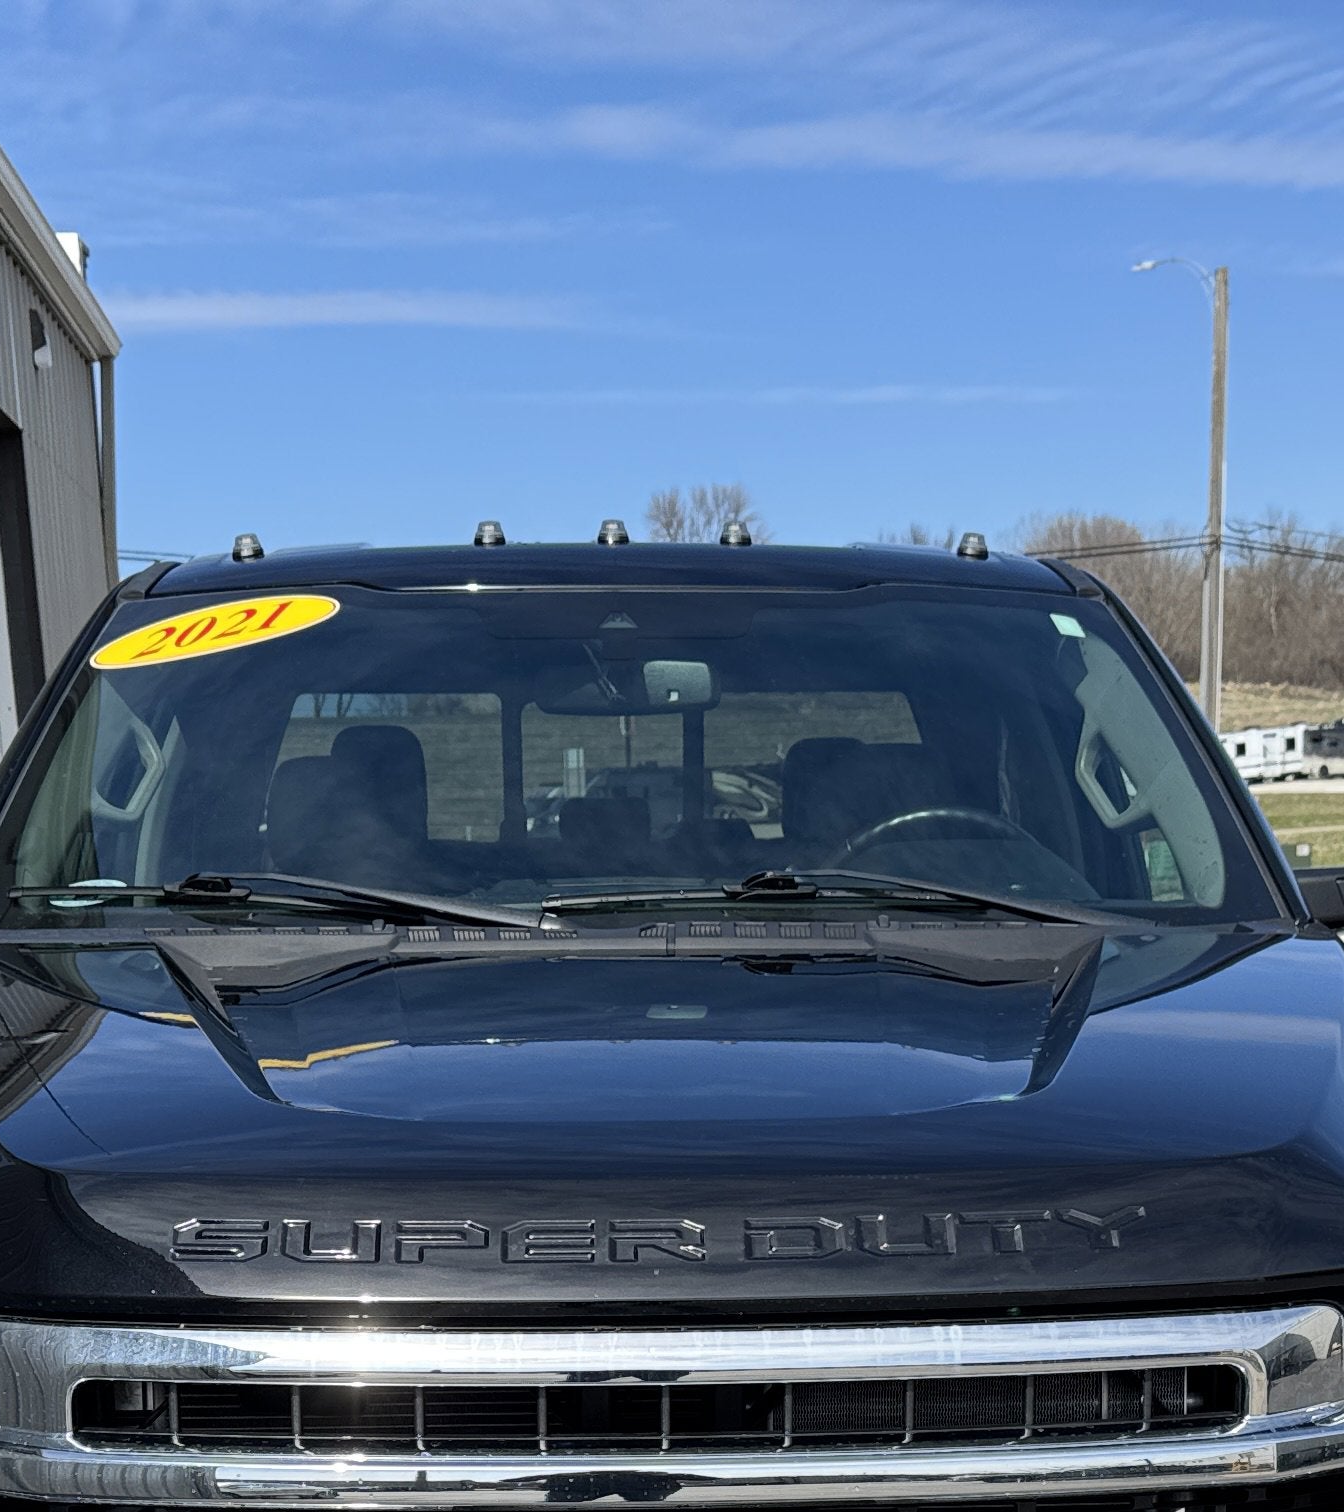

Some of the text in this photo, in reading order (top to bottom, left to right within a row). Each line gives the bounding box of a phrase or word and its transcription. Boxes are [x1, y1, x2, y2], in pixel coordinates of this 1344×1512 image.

[129, 601, 294, 660] 2021
[169, 1206, 1147, 1264] SUPER DUTY
